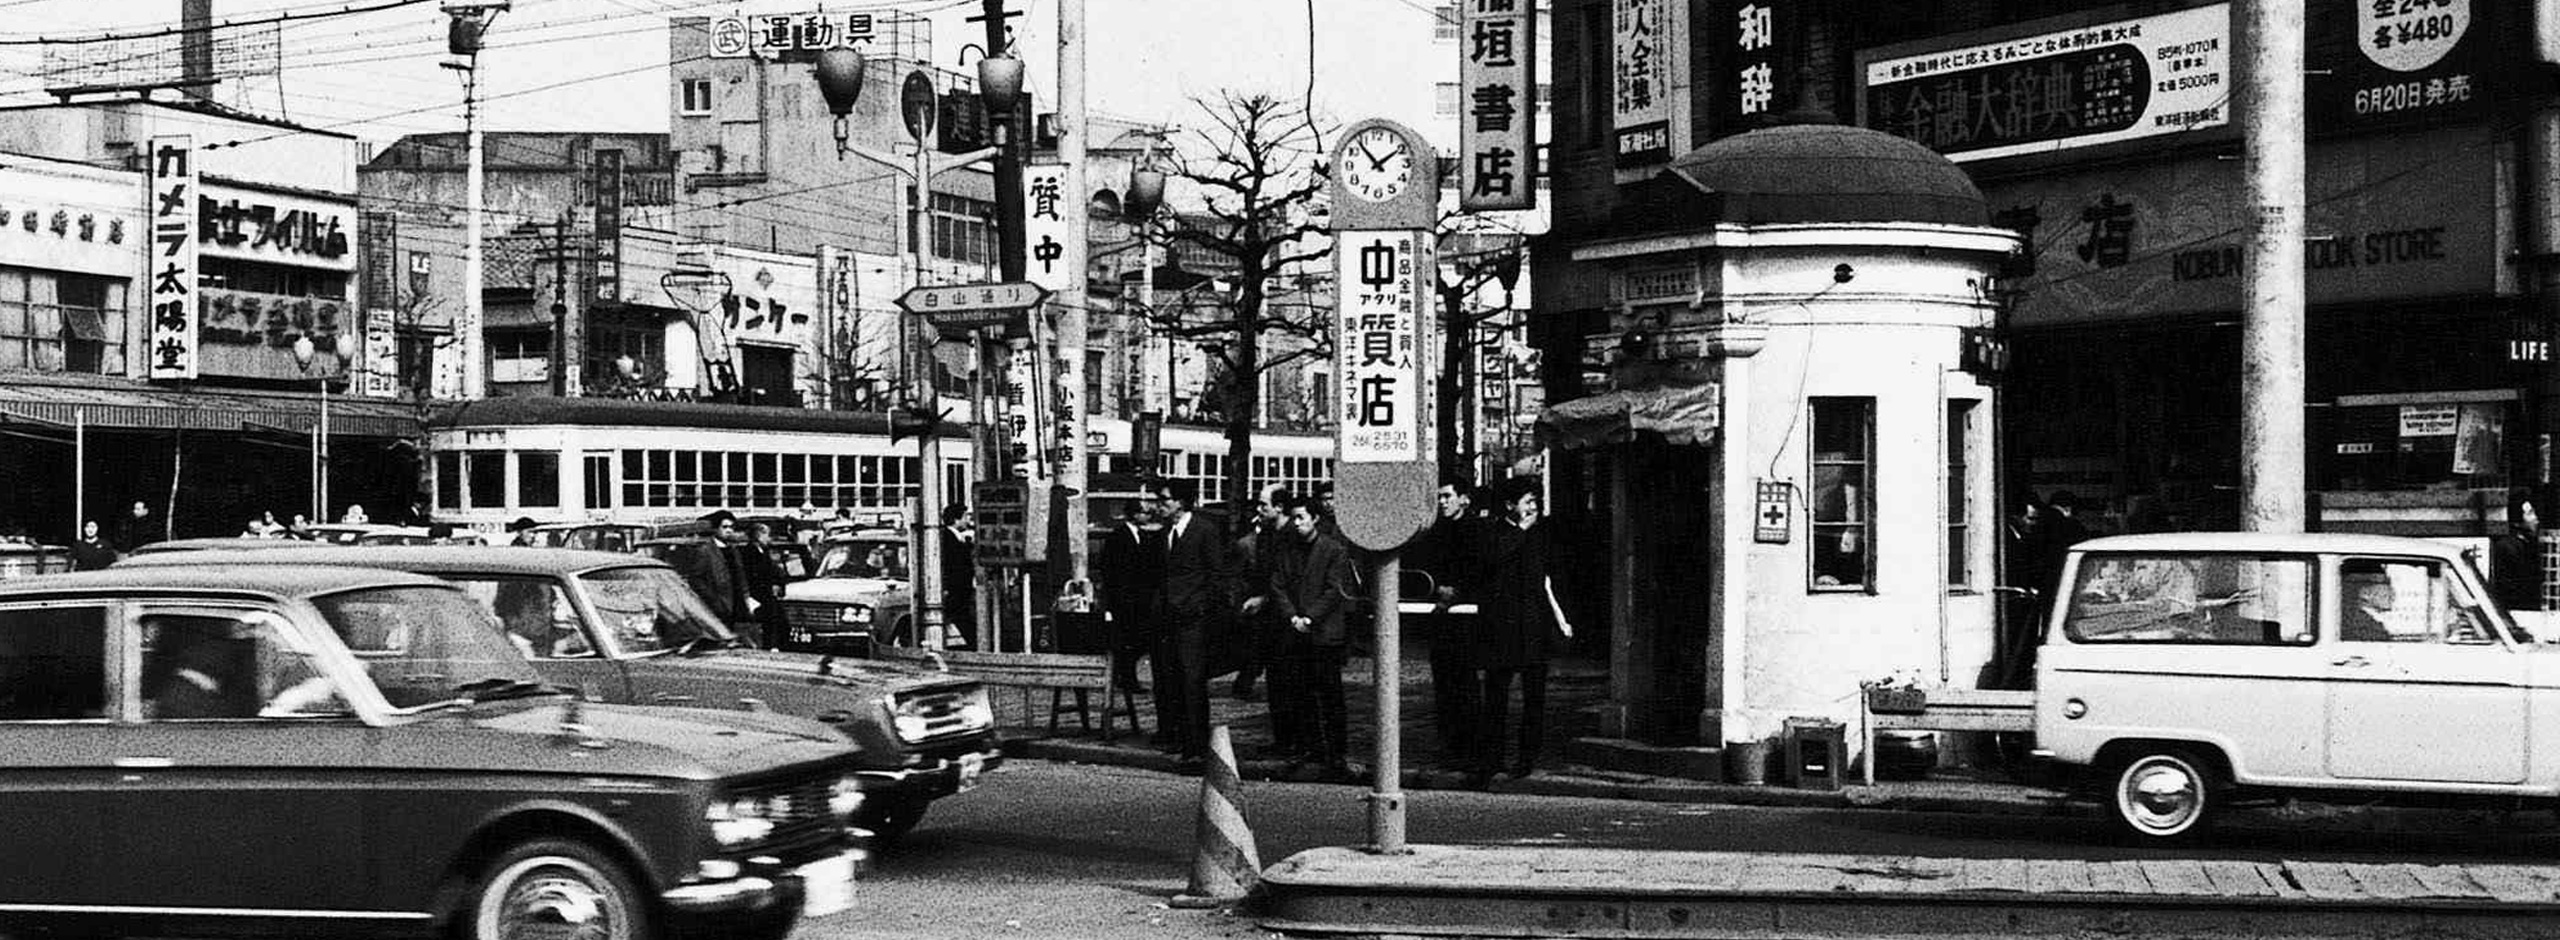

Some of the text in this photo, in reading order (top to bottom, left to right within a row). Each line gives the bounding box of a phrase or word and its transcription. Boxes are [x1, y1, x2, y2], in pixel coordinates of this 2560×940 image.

[761, 14, 875, 47] 運動具
[1631, 0, 1651, 110] 人全集
[1739, 3, 1773, 114] 和辞
[1470, 0, 1515, 198] 垣書店
[2355, 75, 2471, 113] 6月20日発売
[1030, 176, 1063, 274] 質中
[154, 145, 188, 371] カメラ太陽堂
[2364, 227, 2446, 265] STORE
[925, 289, 1020, 307] 白山通り
[1360, 294, 1396, 305] アタリ
[2510, 340, 2549, 361] LIFE
